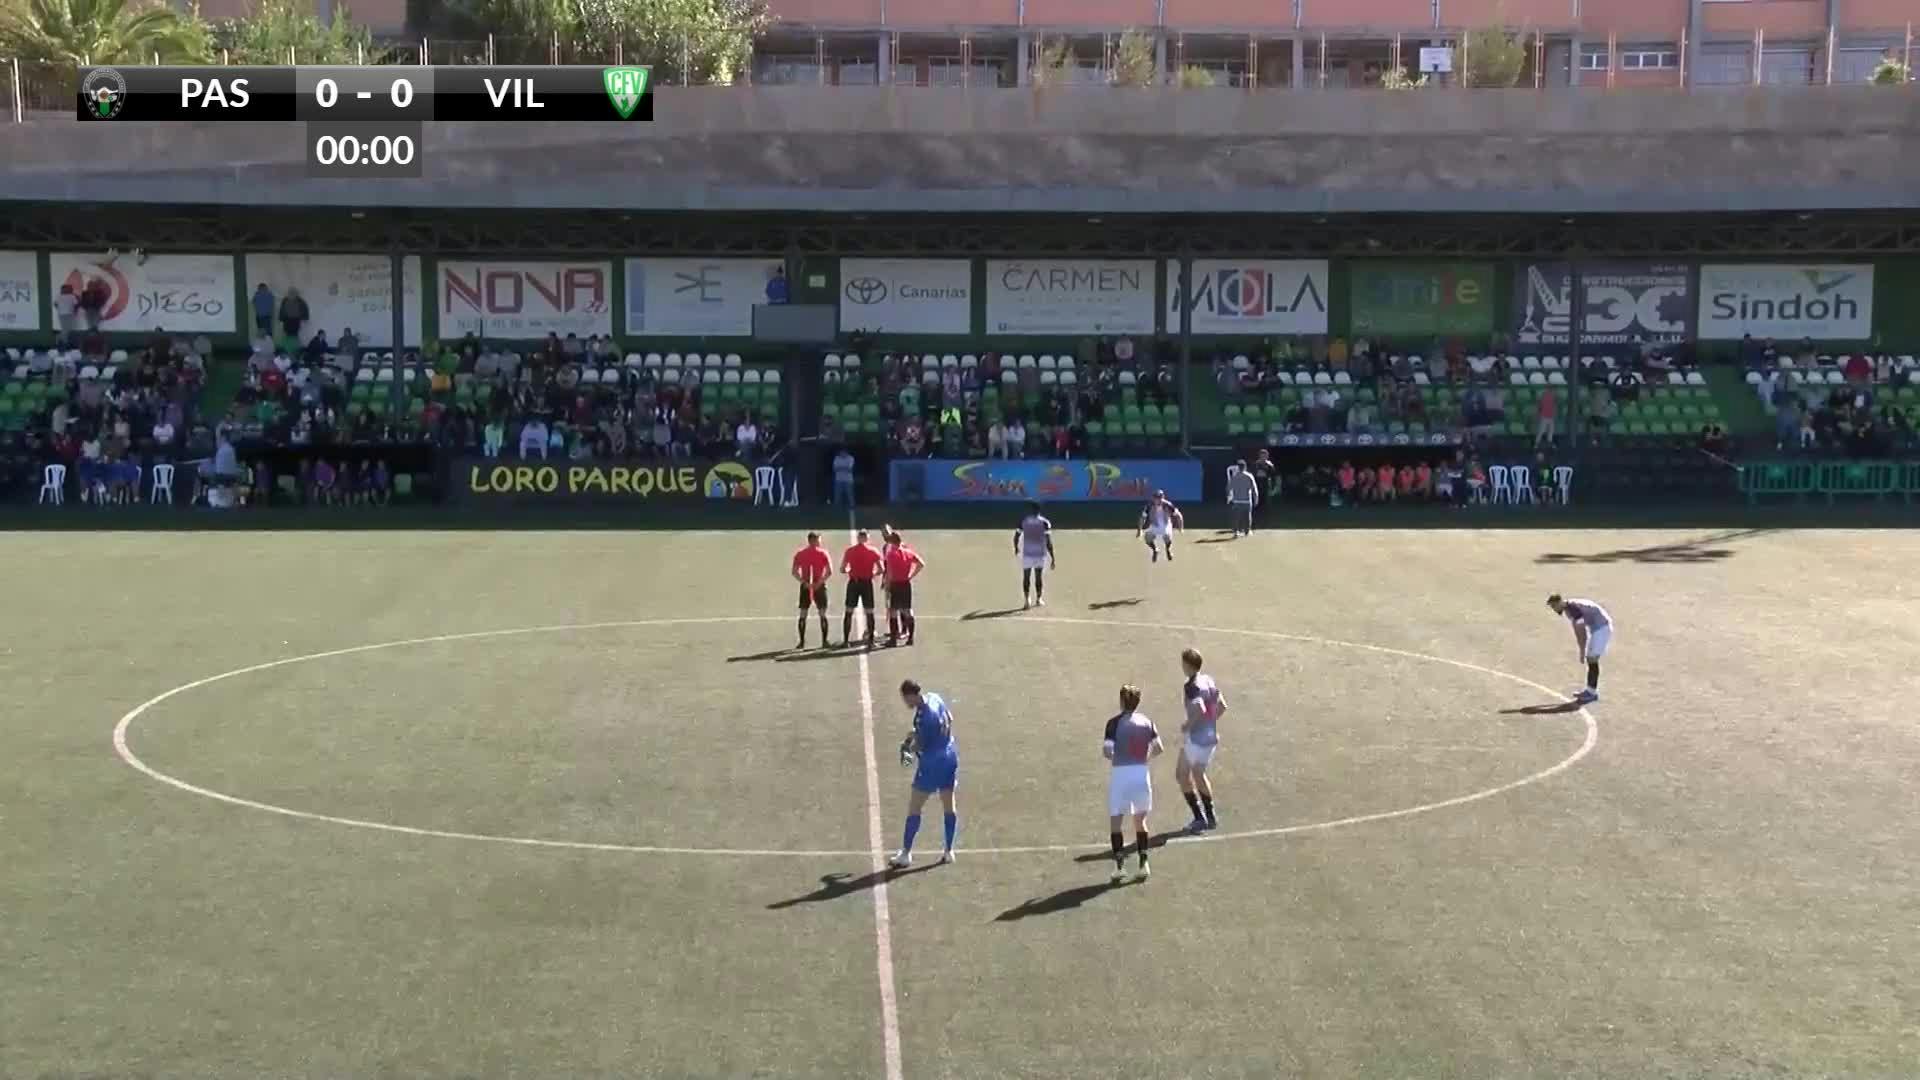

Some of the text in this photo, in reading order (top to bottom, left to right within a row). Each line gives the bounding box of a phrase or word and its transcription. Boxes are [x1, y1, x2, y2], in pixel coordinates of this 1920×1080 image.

[445, 267, 605, 314] NOVA
[900, 284, 967, 300] Canarias
[1002, 268, 1139, 292] CARMEN
[137, 291, 223, 317] DIEGO
[1711, 293, 1856, 320] Sindoh
[471, 466, 696, 497] LORO PARQUE
